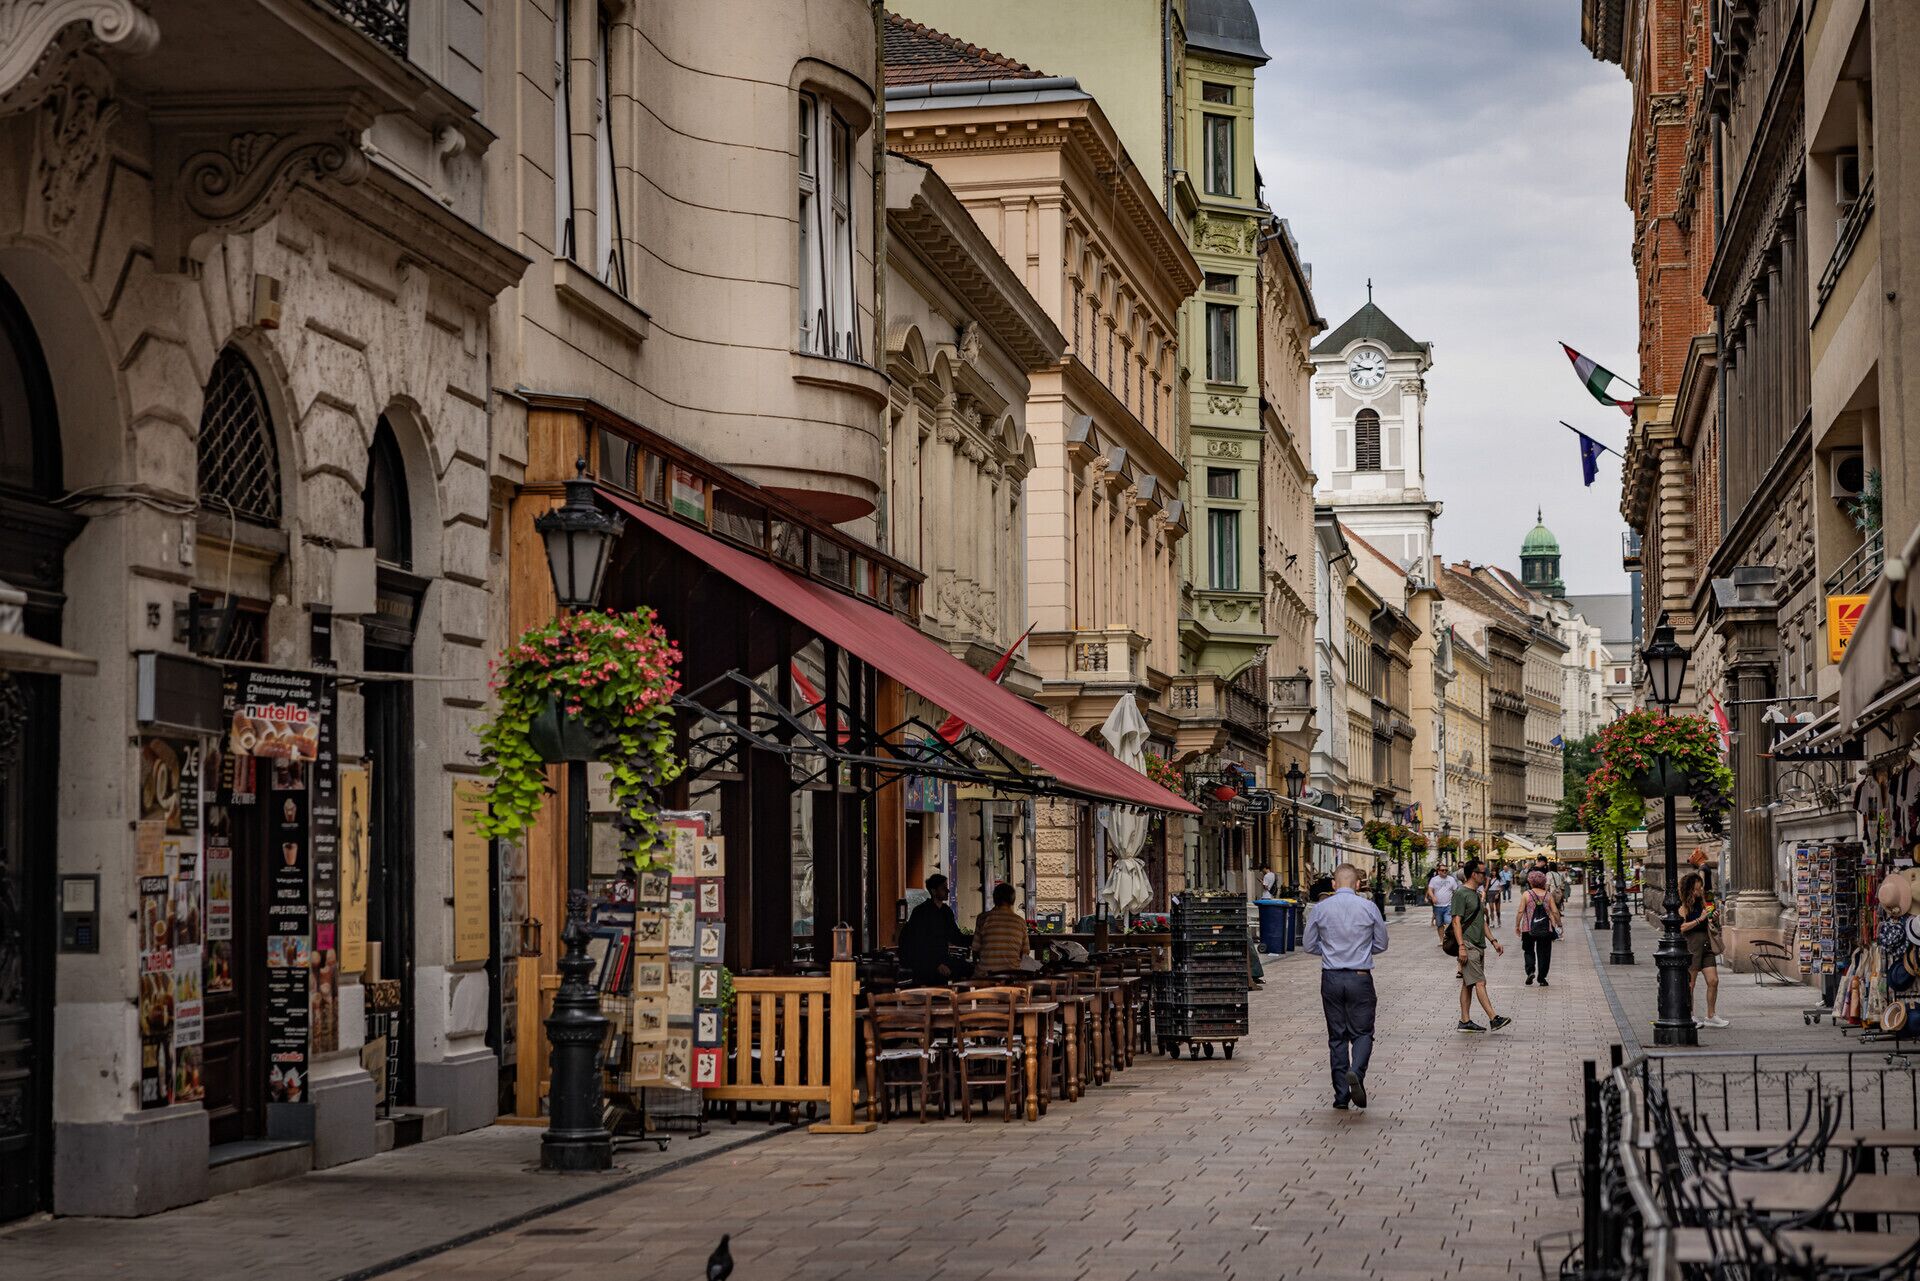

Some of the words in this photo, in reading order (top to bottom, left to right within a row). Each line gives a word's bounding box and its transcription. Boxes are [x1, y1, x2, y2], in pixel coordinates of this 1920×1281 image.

[246, 684, 288, 699] Chimney
[288, 688, 313, 699] cake
[246, 704, 308, 722] nutella
[141, 877, 168, 893] VEGAN
